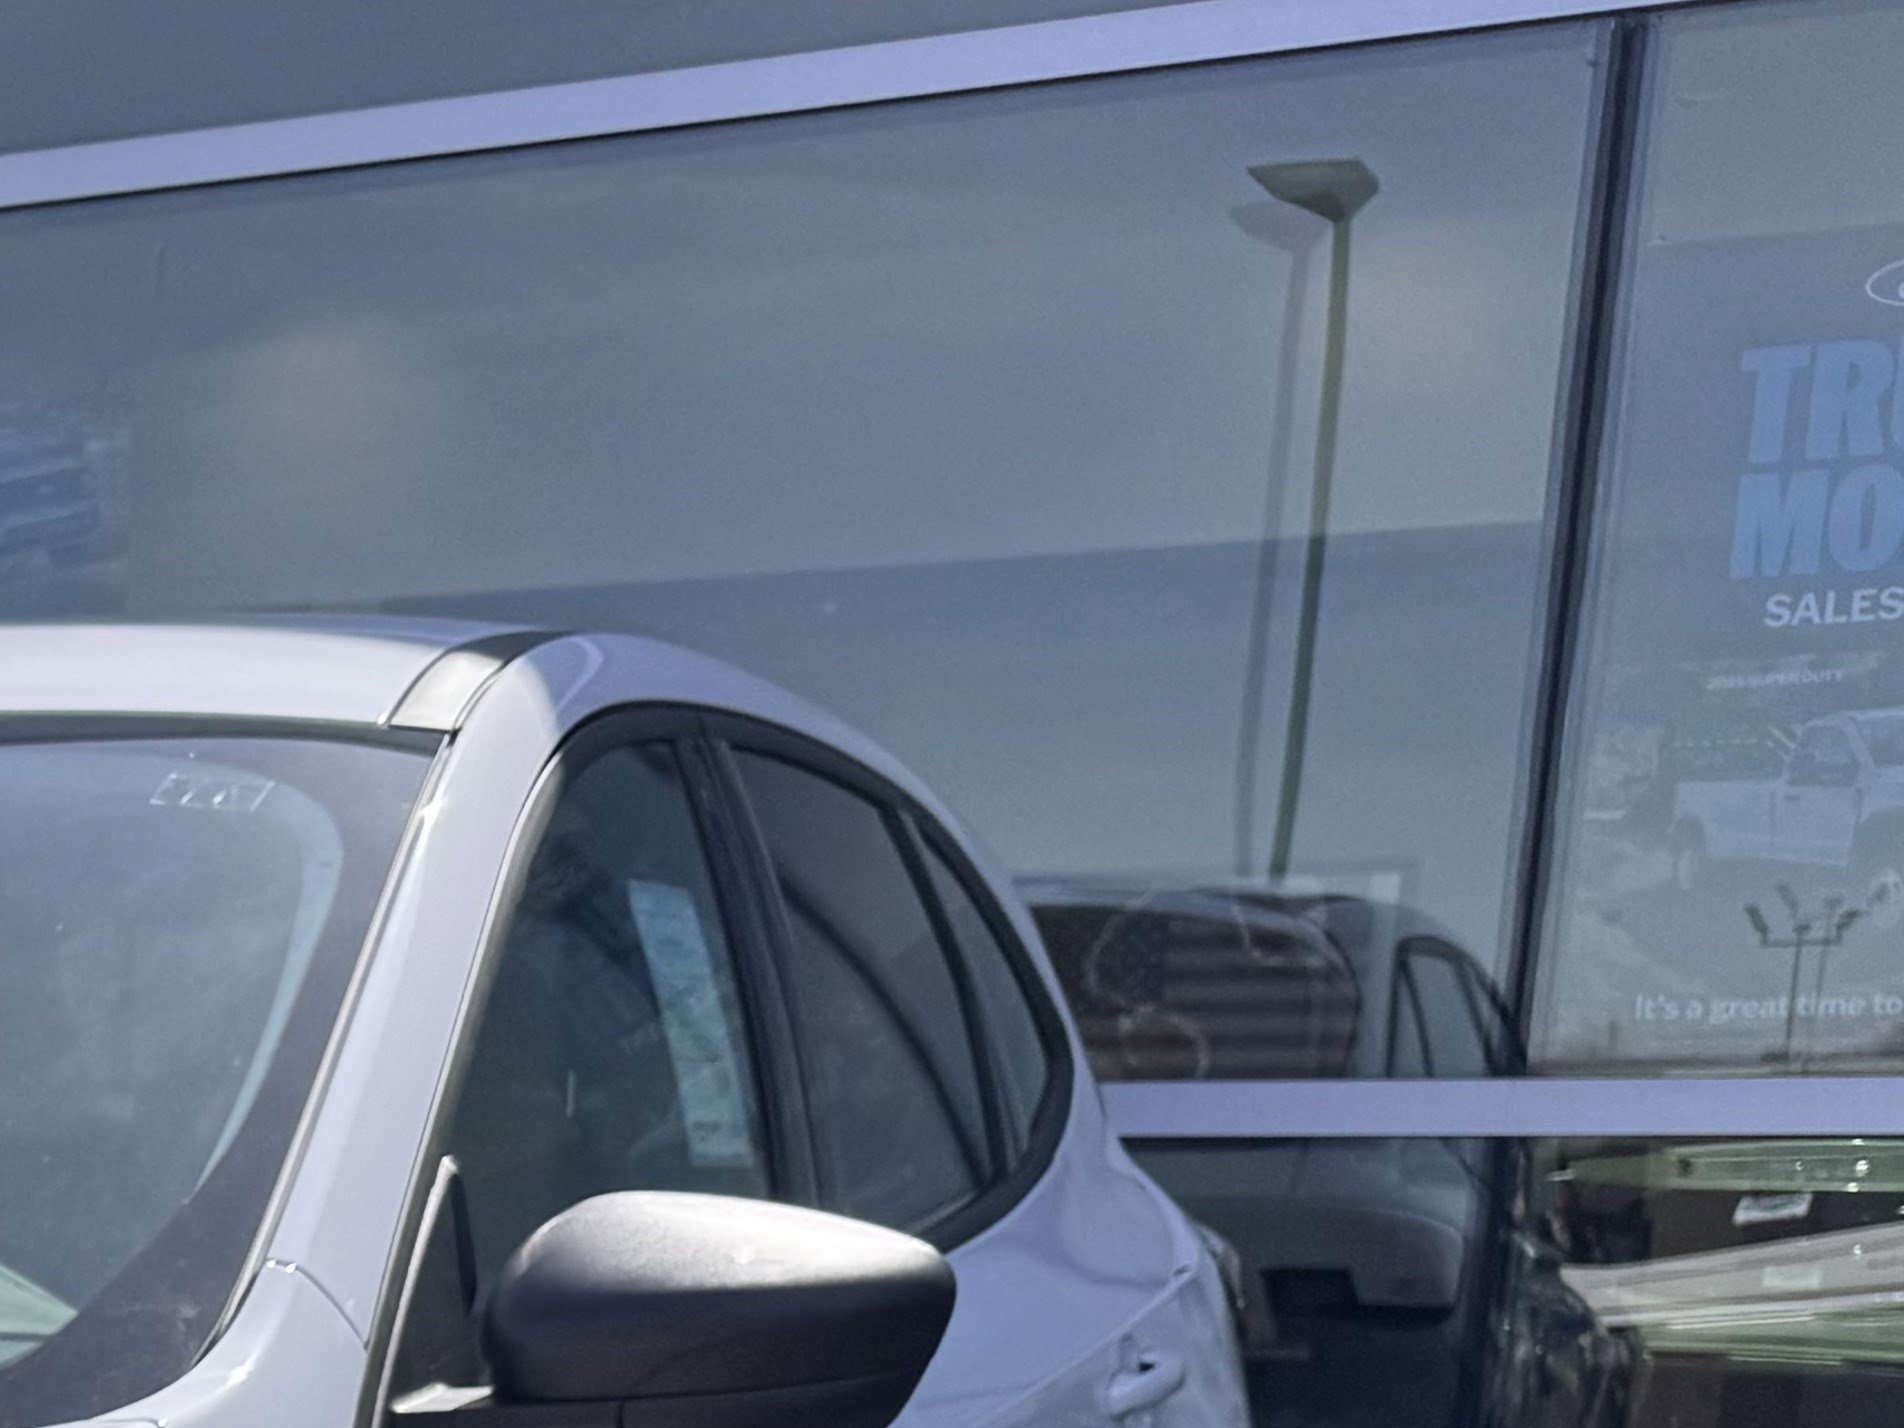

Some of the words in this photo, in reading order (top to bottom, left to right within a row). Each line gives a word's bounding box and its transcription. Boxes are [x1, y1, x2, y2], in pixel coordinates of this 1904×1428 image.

[1741, 336, 1904, 464] TR
[1763, 586, 1904, 628] SALES
[1635, 994, 1680, 1021] It's
[1709, 994, 1790, 1025] great
[1796, 992, 1866, 1018] time
[1872, 992, 1904, 1017] to
